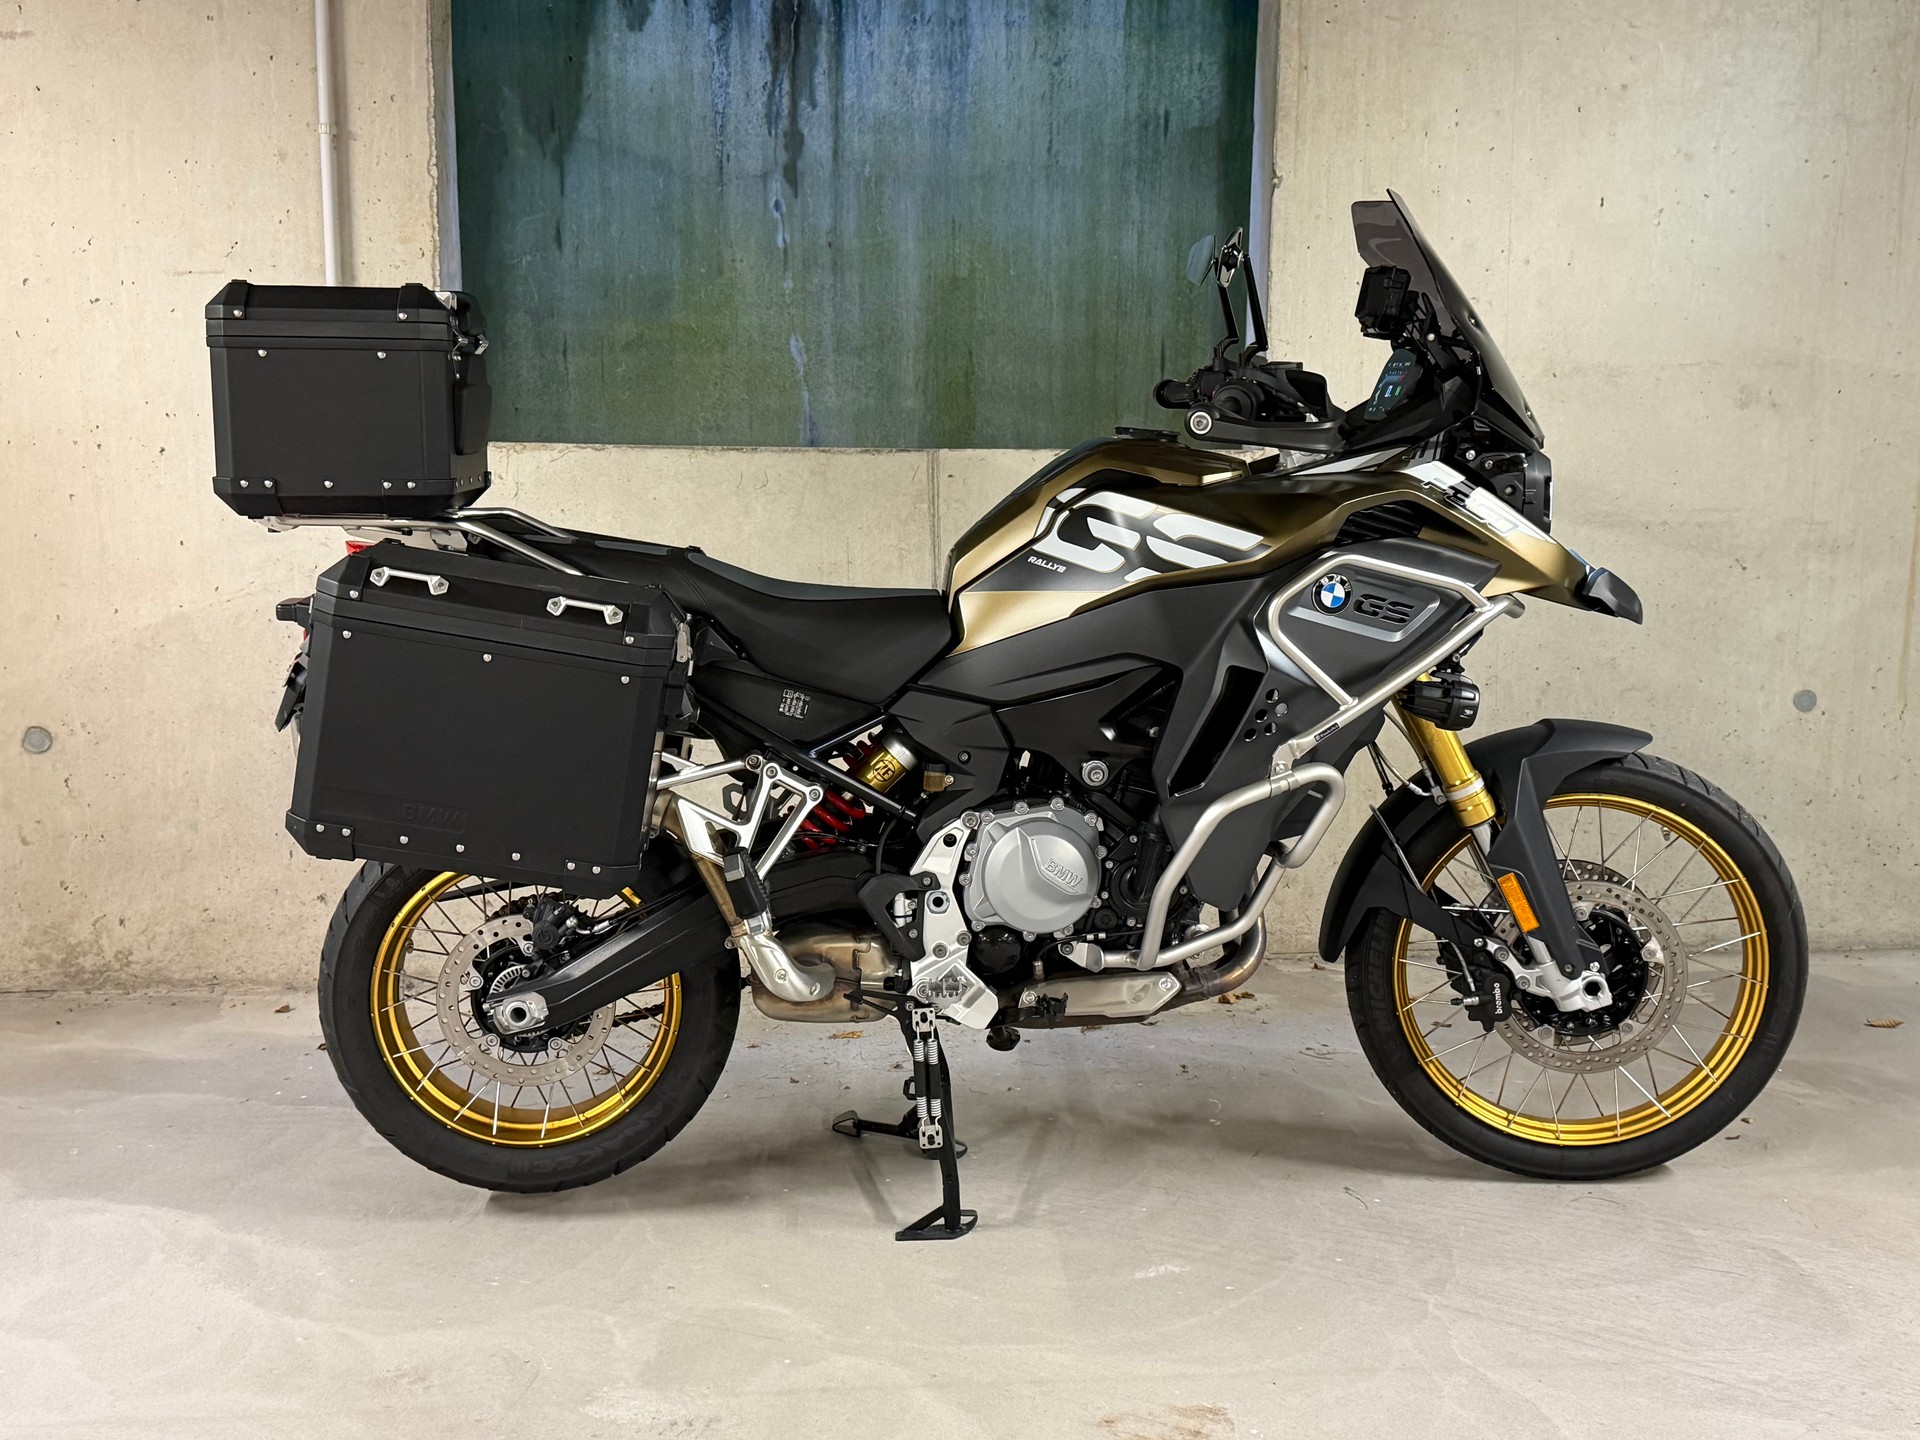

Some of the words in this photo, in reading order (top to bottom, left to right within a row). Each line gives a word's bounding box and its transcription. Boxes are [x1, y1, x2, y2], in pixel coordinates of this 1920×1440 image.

[1032, 487, 1265, 582] GS
[1027, 555, 1067, 573] RALLYE
[1353, 593, 1415, 624] GS
[1045, 858, 1083, 888] BMW
[1493, 982, 1503, 1015] brembo
